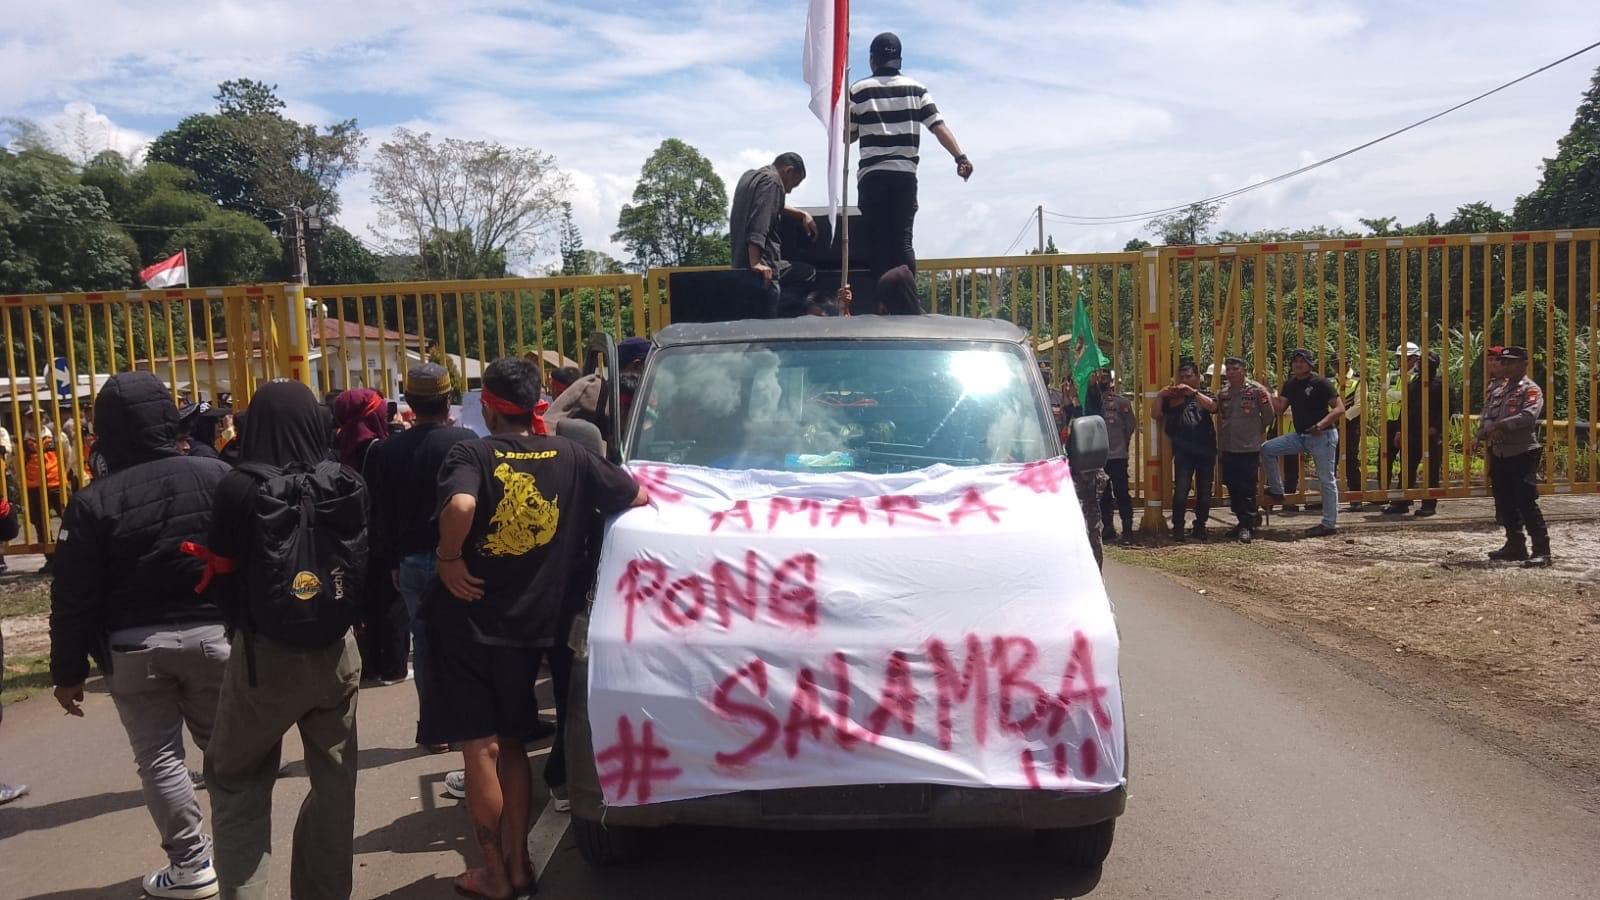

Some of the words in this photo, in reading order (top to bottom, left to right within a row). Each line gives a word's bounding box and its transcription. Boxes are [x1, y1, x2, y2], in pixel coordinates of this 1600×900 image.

[505, 450, 558, 460] DUNLOP
[712, 488, 1005, 531] AMARA
[616, 549, 820, 643] PONG
[711, 630, 1112, 768] SALAMBA
